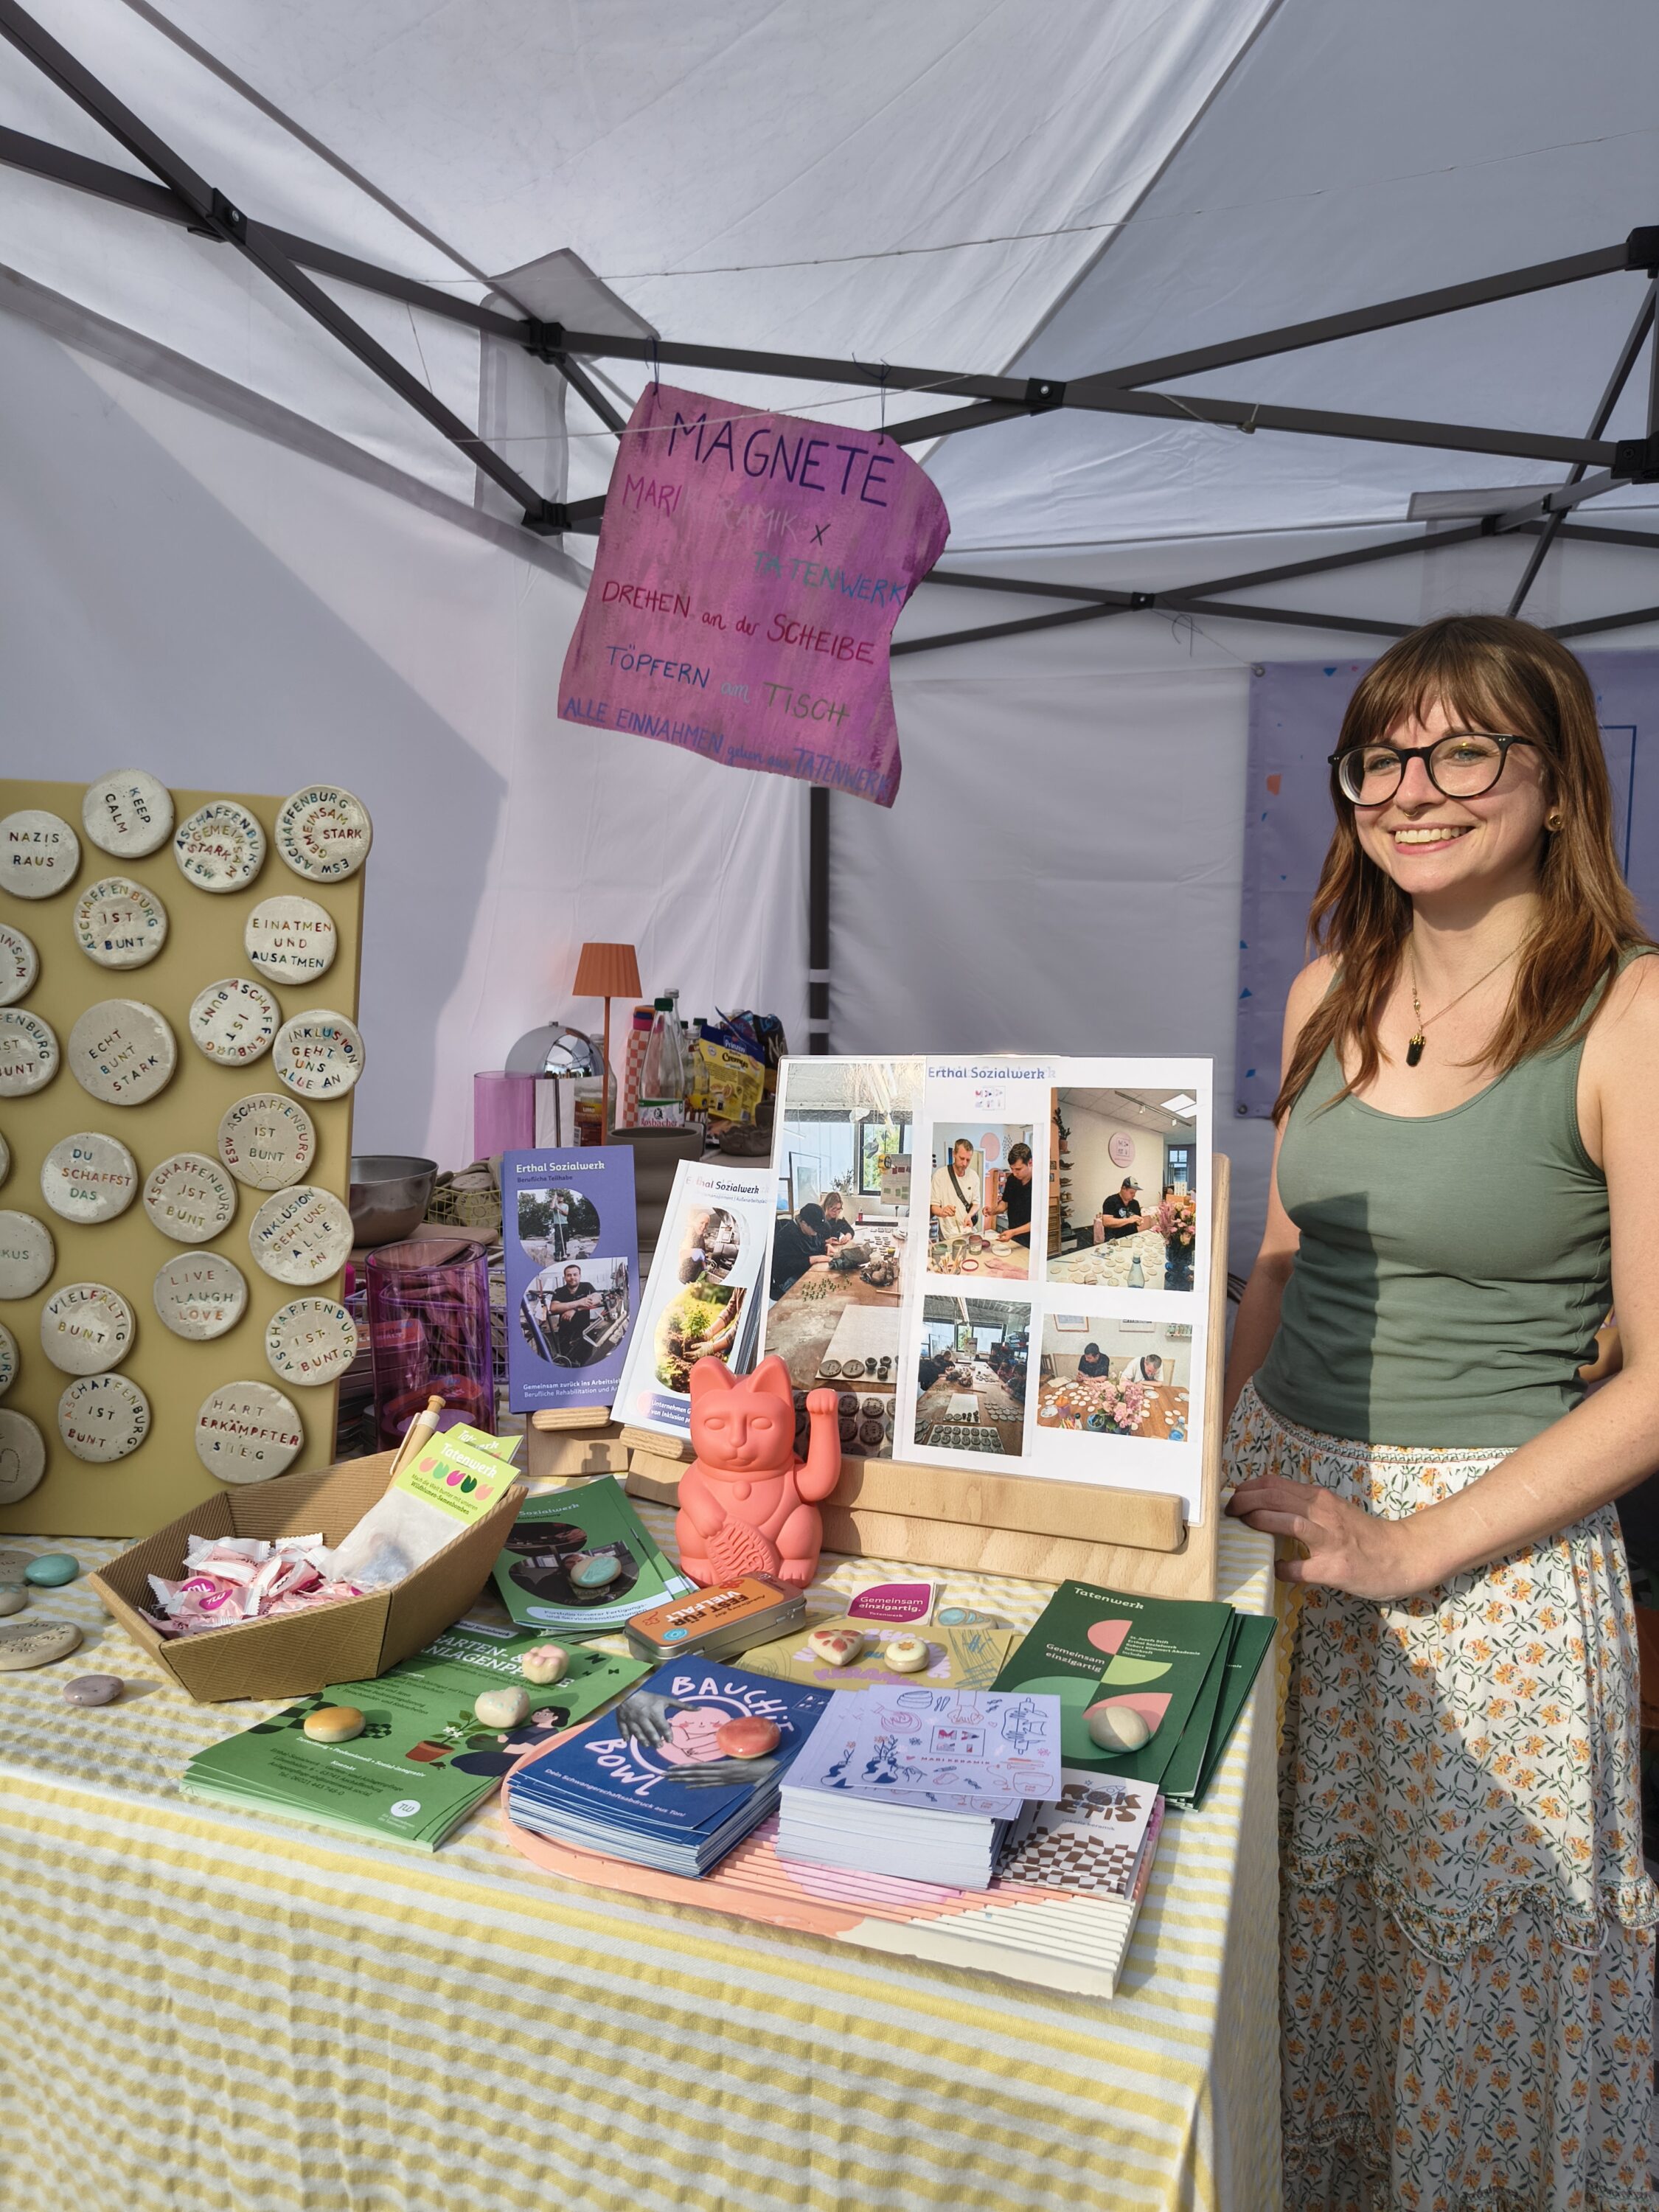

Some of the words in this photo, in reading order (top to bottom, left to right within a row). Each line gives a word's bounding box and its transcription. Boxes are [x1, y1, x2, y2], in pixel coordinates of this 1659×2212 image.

[667, 411, 894, 507] MAGNETE
[622, 473, 682, 518] MARI
[754, 551, 906, 608] TATENWERK
[602, 581, 690, 618] DREHEN
[702, 611, 726, 630] an
[736, 616, 760, 636] der
[767, 613, 875, 665] SCHEIBE
[606, 644, 710, 689] TÖPFERN
[720, 681, 751, 703] am
[762, 681, 851, 727] TISCH
[563, 697, 608, 723] ALLE
[616, 708, 724, 754] EINNAHMEN
[793, 747, 894, 797] TATENWERK
[105, 793, 128, 833] CALM
[129, 787, 150, 824] KEEP
[9, 832, 60, 844] NAZIS
[282, 791, 349, 871] ASCHAFFENBURG
[303, 807, 349, 860] GEMEINSAM
[323, 829, 362, 839] STARK
[13, 855, 55, 867] RAUS
[187, 842, 232, 861] STARK
[192, 825, 244, 879] GEMEINSAM
[184, 859, 215, 880] ESW
[321, 858, 349, 874] ESW
[79, 884, 158, 950] ASCHAFFENBURG
[102, 912, 133, 924] IST
[252, 919, 332, 932] EINATMEN
[105, 937, 145, 950] BUNT
[274, 938, 307, 949] UND
[251, 950, 324, 968] AUSATMEN
[199, 991, 229, 1026] BUNT
[206, 979, 273, 1057] ASCHAFFENBURG
[226, 1013, 249, 1041] IST
[88, 1029, 122, 1060] ECHT
[288, 1026, 358, 1064] INKLUSION
[292, 1045, 335, 1059] GEHT
[725, 1039, 745, 1053] Prinzen
[0, 1062, 34, 1077] UNT
[100, 1045, 136, 1074] BUNT
[296, 1060, 326, 1073] UNS
[113, 1055, 159, 1091] STARK
[279, 1068, 314, 1090] ALLE
[322, 1074, 341, 1089] AN
[928, 1067, 967, 1078] Erthal
[971, 1067, 1045, 1079] Sozialwerk
[227, 1099, 309, 1164] ASCHAFFENBURG
[254, 1127, 276, 1138] IST
[641, 1118, 678, 1127] Rosbacher
[72, 1149, 93, 1161] DU
[225, 1137, 239, 1165] ESW
[249, 1147, 285, 1161] BUNT
[62, 1167, 131, 1186] SCHAFFST
[516, 1164, 547, 1173] Erthal
[549, 1161, 605, 1172] Sozialwerk
[70, 1188, 97, 1200] DAS
[147, 1161, 229, 1222] ASCHAFFENBURG
[181, 1184, 207, 1200] IST
[715, 1181, 759, 1194] Sozialwerk
[166, 1206, 206, 1227] BUNT
[258, 1190, 315, 1242] INKLUSION
[272, 1223, 303, 1253] GEHT
[303, 1203, 327, 1224] UNS
[291, 1222, 332, 1259] ALLE
[309, 1252, 327, 1269] AN
[170, 1270, 215, 1286] LIVE
[175, 1293, 234, 1304] LAUGH
[49, 1290, 127, 1340] VIELFÄLTIG
[179, 1310, 224, 1321] LOVE
[58, 1321, 105, 1343] BUNT
[270, 1301, 355, 1370] ASCHAFFENBURG
[294, 1329, 324, 1346] IST
[301, 1349, 339, 1372] BUNT
[523, 1382, 559, 1391] Gemeinsam
[524, 1390, 554, 1398] Berufliche
[555, 1388, 597, 1396] Rehabilitation
[63, 1377, 146, 1447] ASCHAFFENBURG
[88, 1406, 116, 1421] IST
[213, 1399, 265, 1416] HART
[651, 1399, 686, 1413] Unternehmen
[661, 1410, 685, 1422] Inklusion
[68, 1428, 107, 1449] BUNT
[201, 1416, 299, 1446] ERKÄMPFTER
[213, 1441, 264, 1461] SIEG
[441, 1442, 498, 1478] Tatenwerk
[439, 1486, 454, 1498] bunter
[518, 1503, 580, 1516] Sozialwerk
[665, 1590, 742, 1623] VIELFALT
[711, 1594, 750, 1613] FEST
[858, 1602, 921, 1613] einzigartig.
[860, 1596, 923, 1605] Gemeinsam
[1074, 1587, 1144, 1610] Tatenwerk
[672, 1612, 707, 1627] FÜR
[1045, 1652, 1103, 1673] einzigartig
[1046, 1642, 1106, 1666] Gemeinsam
[584, 1738, 669, 1796] BOWL
[544, 1768, 562, 1778] Dein
[562, 1774, 655, 1809] Schwangerschaftsabdruck
[654, 1805, 669, 1813] aus
[668, 1809, 686, 1818] Ton!
[397, 1803, 416, 1813] TW
